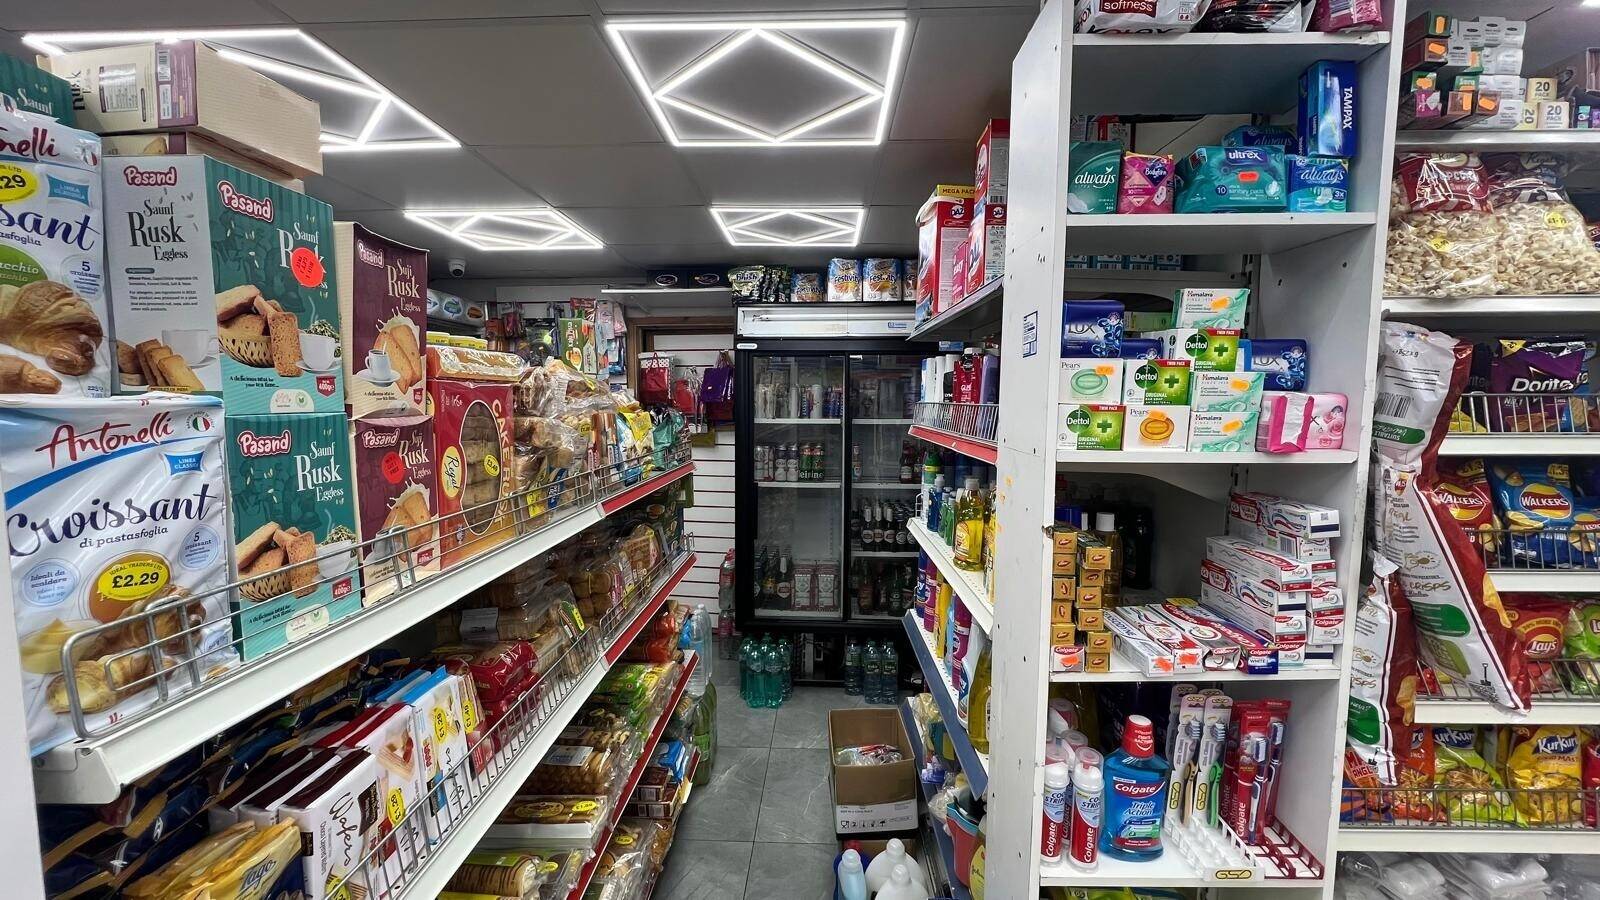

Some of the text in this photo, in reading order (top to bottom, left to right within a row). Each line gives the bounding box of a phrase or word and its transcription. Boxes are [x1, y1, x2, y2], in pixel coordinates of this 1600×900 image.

[1104, 0, 1154, 12] softness
[1535, 82, 1550, 92] 20
[1342, 86, 1353, 130] TAMPAX
[1525, 109, 1535, 124] 20
[1547, 105, 1562, 116] 20
[1228, 150, 1262, 161] ultrex
[124, 166, 176, 186] Pasand
[1075, 170, 1117, 189] always
[1300, 167, 1345, 185] always
[1217, 187, 1226, 195] 10
[143, 199, 175, 218] Saunf
[219, 182, 272, 221] Pasand
[126, 210, 186, 248] Rusk
[292, 221, 320, 245] Saunf
[153, 245, 189, 263] Eggless
[357, 240, 384, 268] Pasand
[81, 261, 91, 272] 5
[386, 264, 421, 299] Rusk
[1068, 322, 1096, 335] LUX
[1185, 341, 1208, 351] Dettol
[1061, 361, 1081, 370] Pears
[1253, 356, 1281, 367] LUX
[1135, 371, 1159, 382] Dettol
[1067, 416, 1091, 426] Dettol
[1130, 408, 1149, 417] Pears
[492, 398, 514, 459] CAKE
[35, 411, 175, 470] Antonelli
[239, 430, 291, 456] Pasand
[362, 428, 400, 448] Pasand
[310, 441, 335, 460] Saunf
[398, 440, 430, 469] Rusk
[294, 455, 343, 492] Rusk
[316, 486, 345, 504] Eggless
[1521, 496, 1569, 507] WALKERS
[6, 483, 218, 558] Croissant
[79, 525, 169, 549] di pastasfoglia
[194, 531, 200, 543] 5
[111, 571, 161, 589] £2.29
[1055, 646, 1079, 654] Colgate
[1114, 782, 1157, 796] Colgate
[1123, 807, 1153, 817] Action
[1131, 800, 1156, 811] Triple
[1236, 802, 1246, 837] Colgate
[1045, 822, 1057, 857] Colgate
[1083, 826, 1095, 863] Colgate
